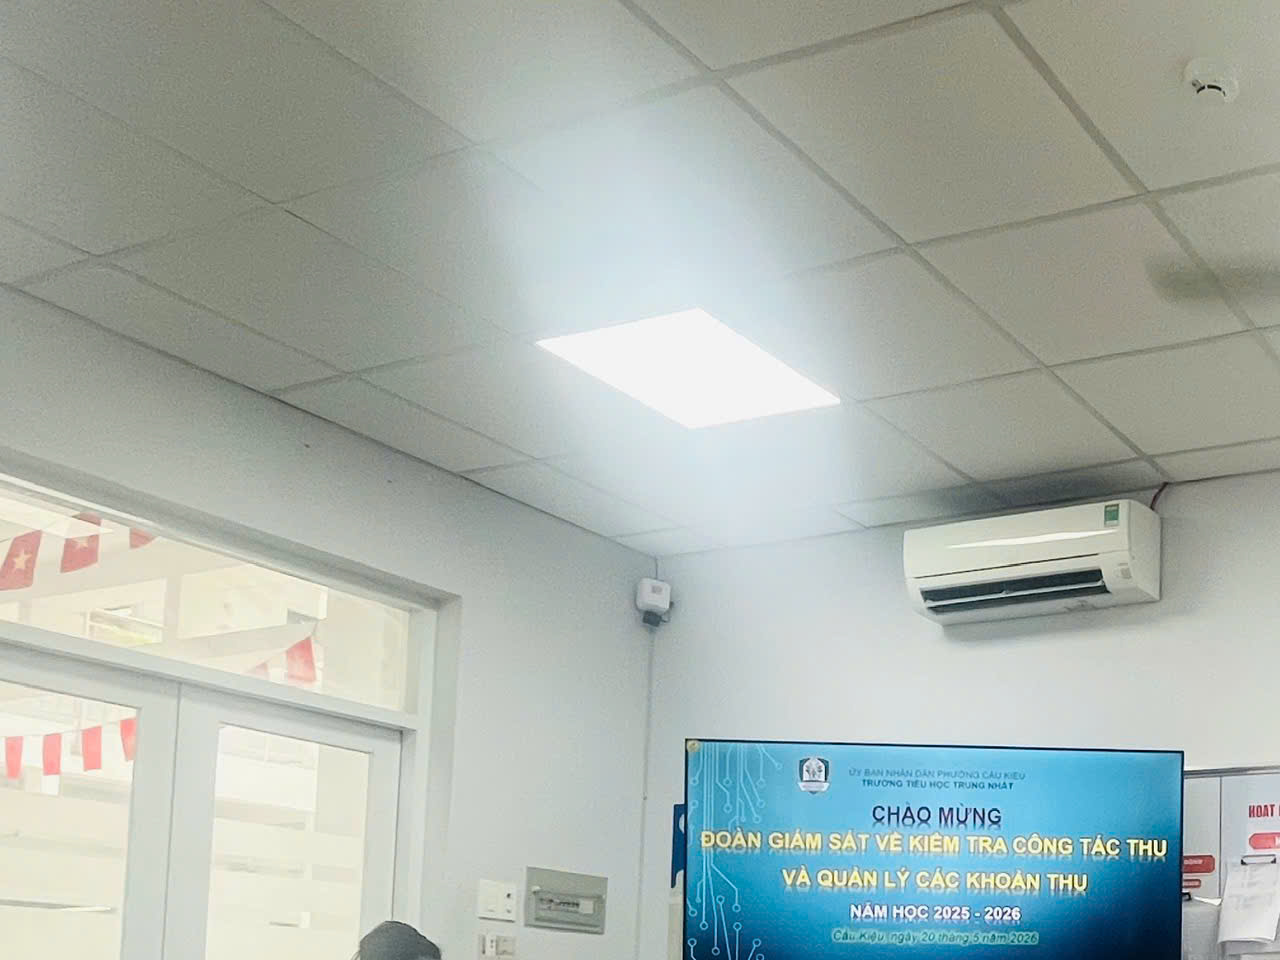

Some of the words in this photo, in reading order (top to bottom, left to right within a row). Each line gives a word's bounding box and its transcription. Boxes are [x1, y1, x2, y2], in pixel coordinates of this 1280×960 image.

[872, 801, 932, 824] CHÀO
[939, 802, 1002, 825] MỪNG
[701, 826, 762, 850] ĐOÀN
[768, 828, 822, 850] GIÁM
[828, 829, 869, 851] SÁT
[967, 836, 1007, 854] TRA
[1012, 832, 1073, 855] CÔNG
[1080, 834, 1121, 856] TÁC
[1126, 838, 1168, 857] THU
[782, 866, 812, 886] VÀ
[884, 867, 911, 888] LÝ
[915, 868, 960, 889] CÁC
[1046, 873, 1088, 892] THU
[849, 901, 888, 919] NĂM
[892, 905, 929, 922] HỌC
[933, 906, 970, 920] 2025
[984, 906, 1021, 921] 2026
[921, 931, 936, 942] 20
[1010, 933, 1039, 944] 2026
